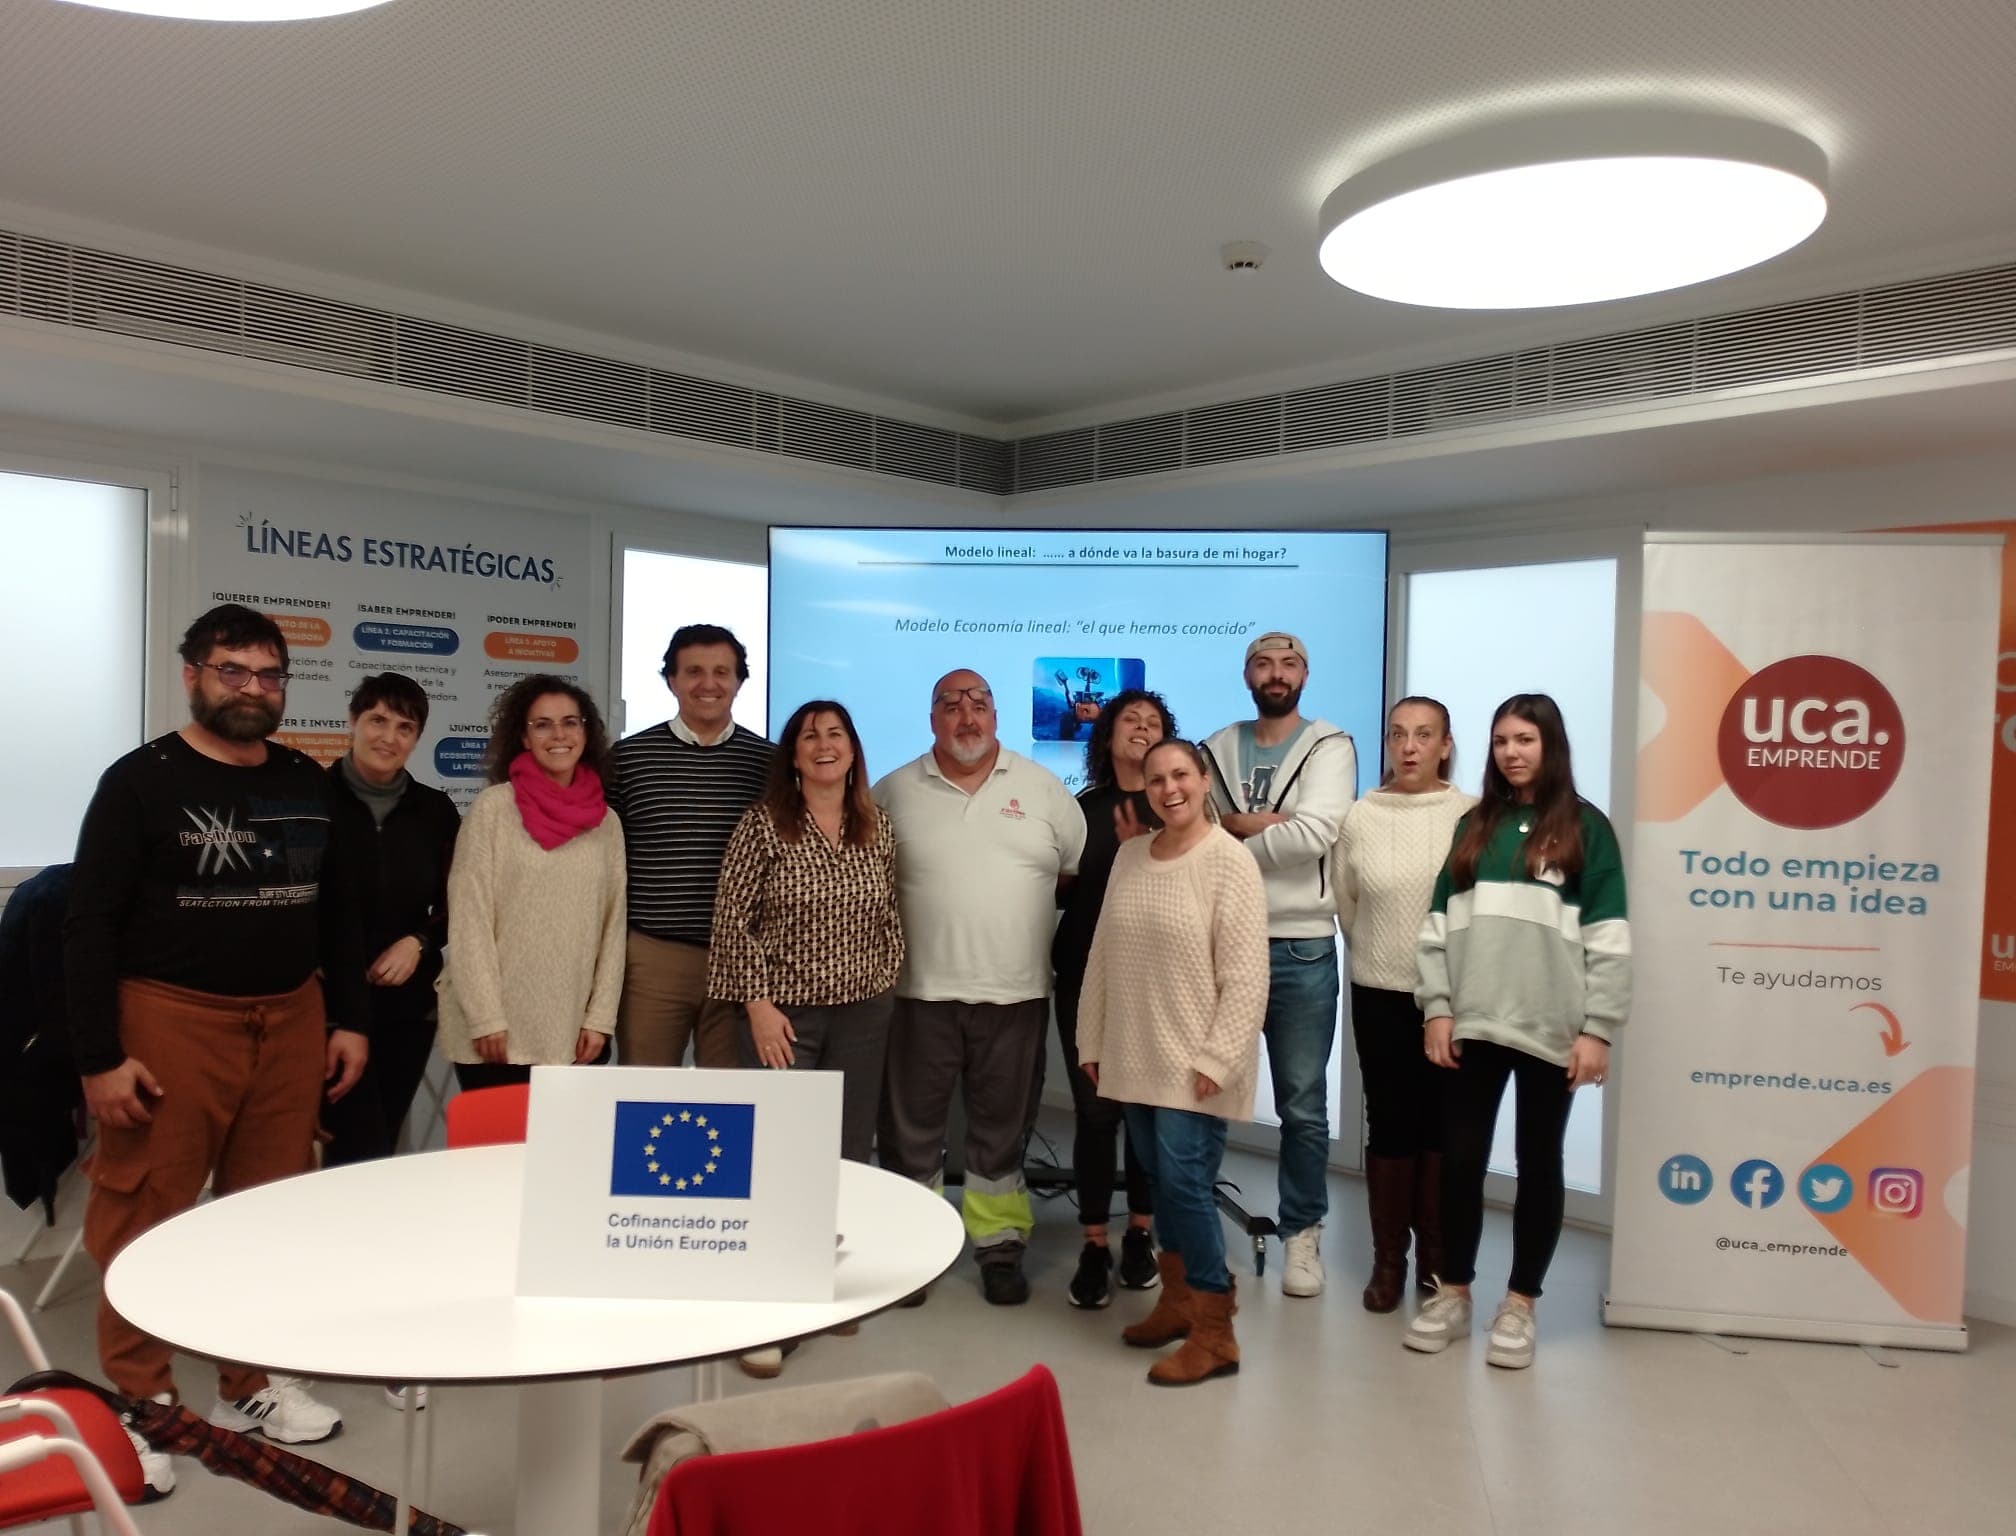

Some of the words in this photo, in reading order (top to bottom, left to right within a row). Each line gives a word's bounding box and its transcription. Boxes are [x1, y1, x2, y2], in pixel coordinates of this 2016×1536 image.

[247, 519, 353, 563] LÍNEAS
[363, 537, 555, 583] ESTRATÉGICAS
[945, 545, 994, 559] Modelo
[997, 545, 1036, 559] lineal:
[1068, 549, 1075, 559] a
[1079, 545, 1119, 559] dónde
[1123, 549, 1138, 559] va
[1141, 546, 1153, 559] la
[1156, 546, 1199, 560] basura
[1203, 546, 1218, 560] de
[1222, 548, 1239, 560] mi
[1242, 546, 1287, 564] hogar?
[263, 596, 331, 609] EMPRENDER!
[396, 607, 456, 619] EMPRENDER!
[487, 615, 520, 626] ¡PODER
[523, 618, 576, 630] EMPRENDER!
[393, 629, 450, 640] CAPACITACIÓN
[895, 619, 949, 633] Modelo
[953, 619, 1023, 633] Economía
[1027, 619, 1070, 633] lineal:
[1098, 624, 1126, 639] que
[1130, 621, 1177, 635] hemos
[320, 658, 334, 667] de
[349, 660, 412, 673] Capacitación
[415, 664, 449, 675] técnica
[451, 667, 457, 677] y
[1747, 748, 1881, 770] EMPRENDE
[1063, 774, 1079, 786] de
[180, 829, 256, 847] Fashion
[1679, 850, 1770, 877] Todo
[1781, 853, 1940, 886] empieza
[242, 899, 270, 907] FROM
[1688, 886, 1755, 910] con
[1768, 889, 1837, 913] una
[1850, 887, 1927, 915] idea
[1717, 966, 1746, 985] Te
[1753, 967, 1883, 992] ayudamos
[1690, 1068, 1893, 1094] emprende.uca.es
[608, 1212, 716, 1231] Cofinanciado
[722, 1217, 749, 1233] por
[606, 1235, 620, 1249] la
[626, 1235, 673, 1250] Unión
[680, 1237, 748, 1254] Europea
[1716, 1236, 1849, 1258] @uca_emprende
